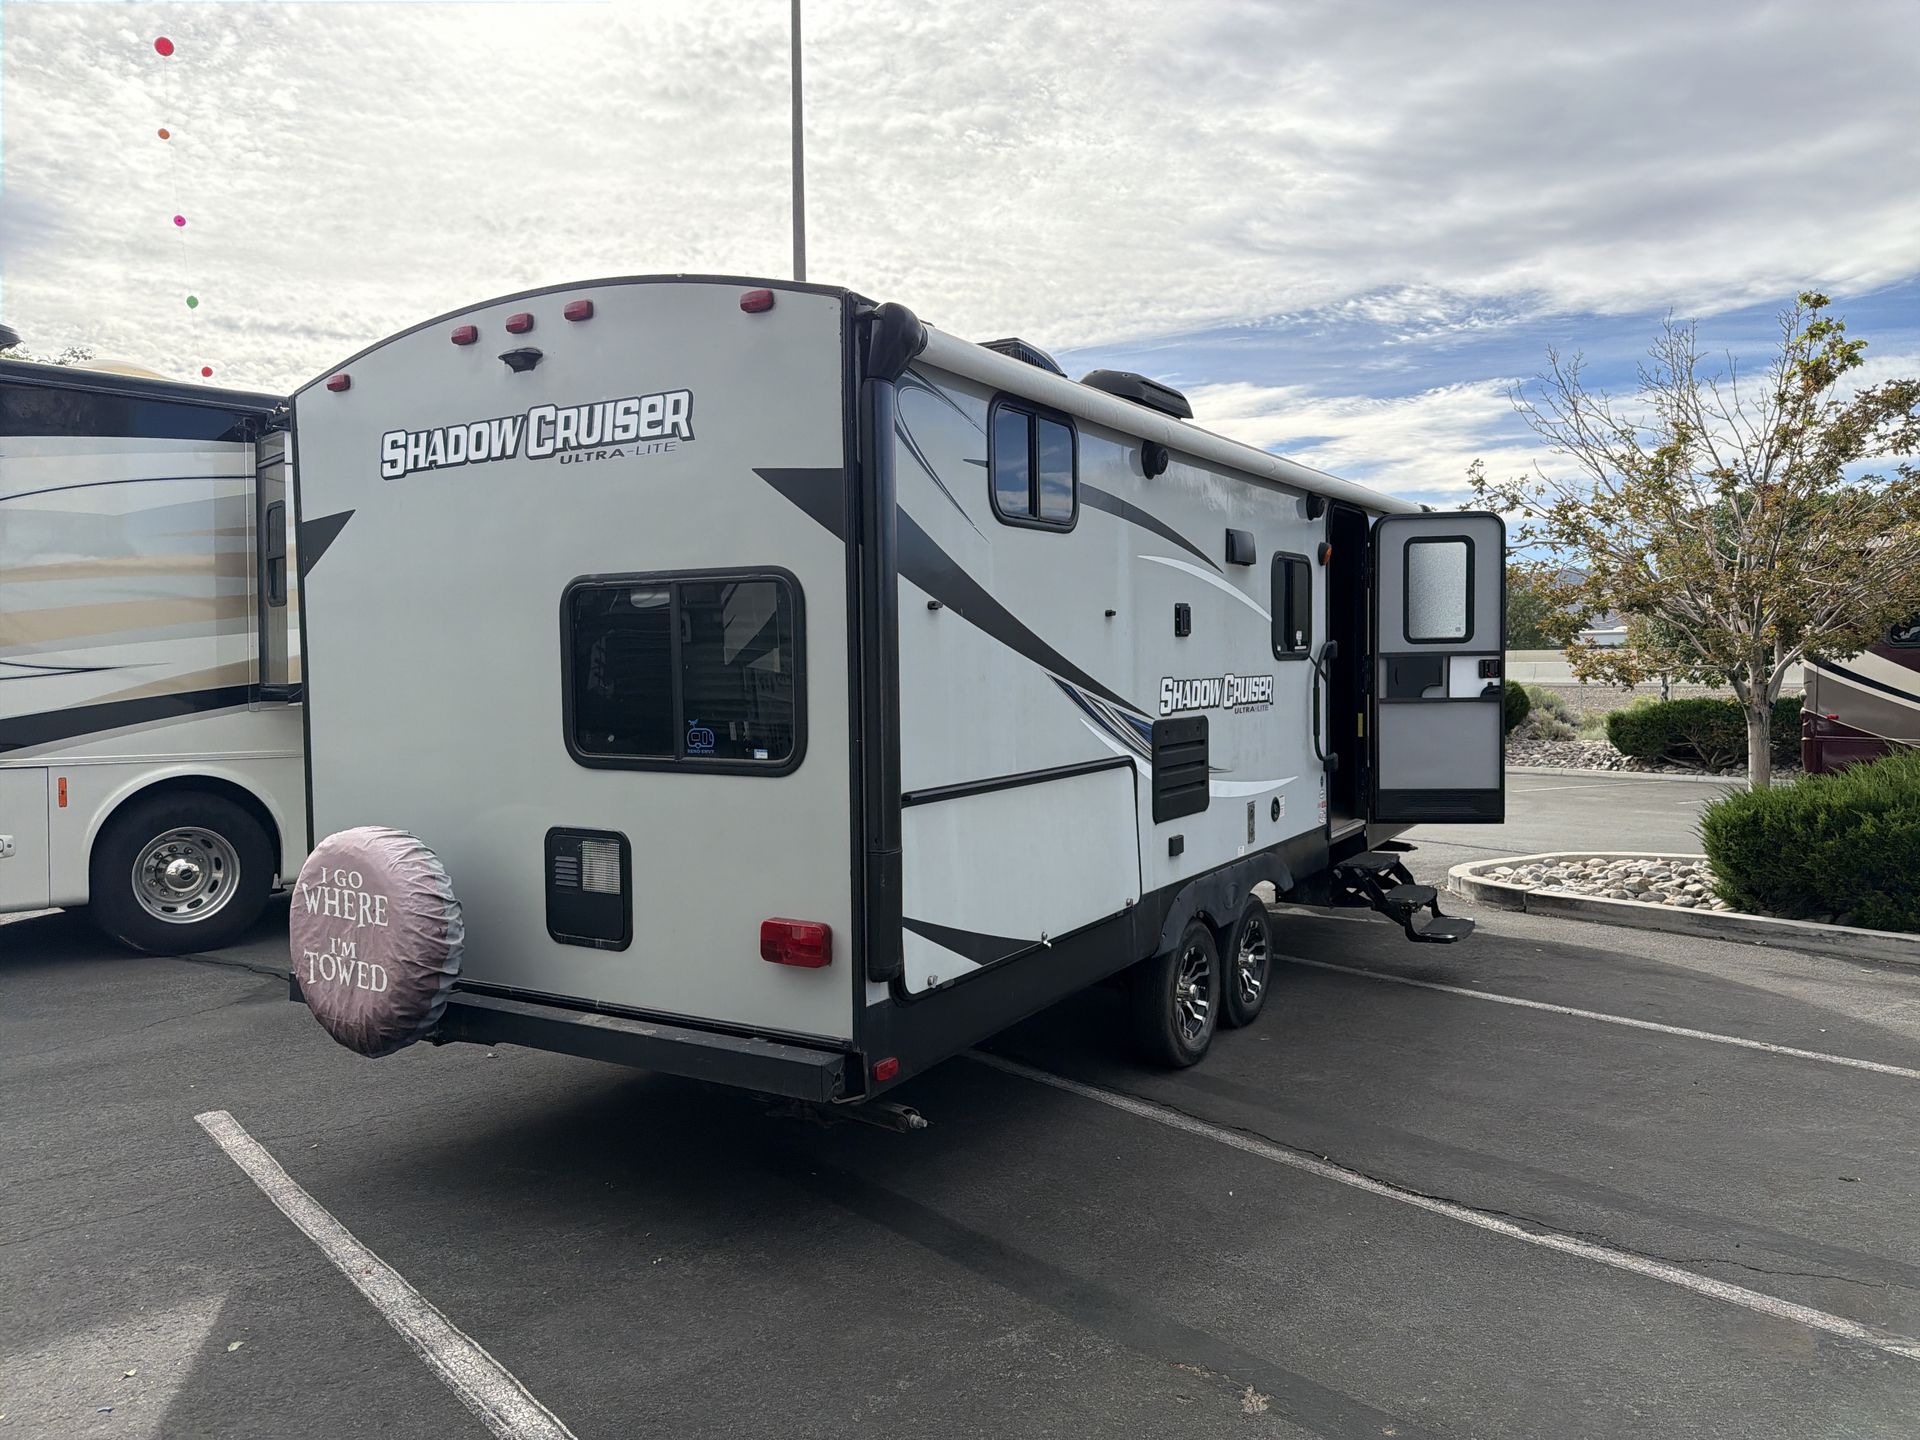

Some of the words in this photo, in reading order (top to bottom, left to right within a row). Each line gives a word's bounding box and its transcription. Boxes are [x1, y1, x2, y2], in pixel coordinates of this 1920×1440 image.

[380, 414, 528, 480] SHADOW
[525, 388, 695, 461] CRUISER
[559, 440, 677, 465] ULTRA-LITE
[1159, 676, 1224, 716] SHADOW
[1223, 673, 1274, 709] CRUISER
[320, 867, 328, 884] I
[333, 869, 363, 889] GO
[302, 882, 389, 928] WHERE
[329, 937, 357, 959] I'M
[303, 948, 389, 993] TOWED
